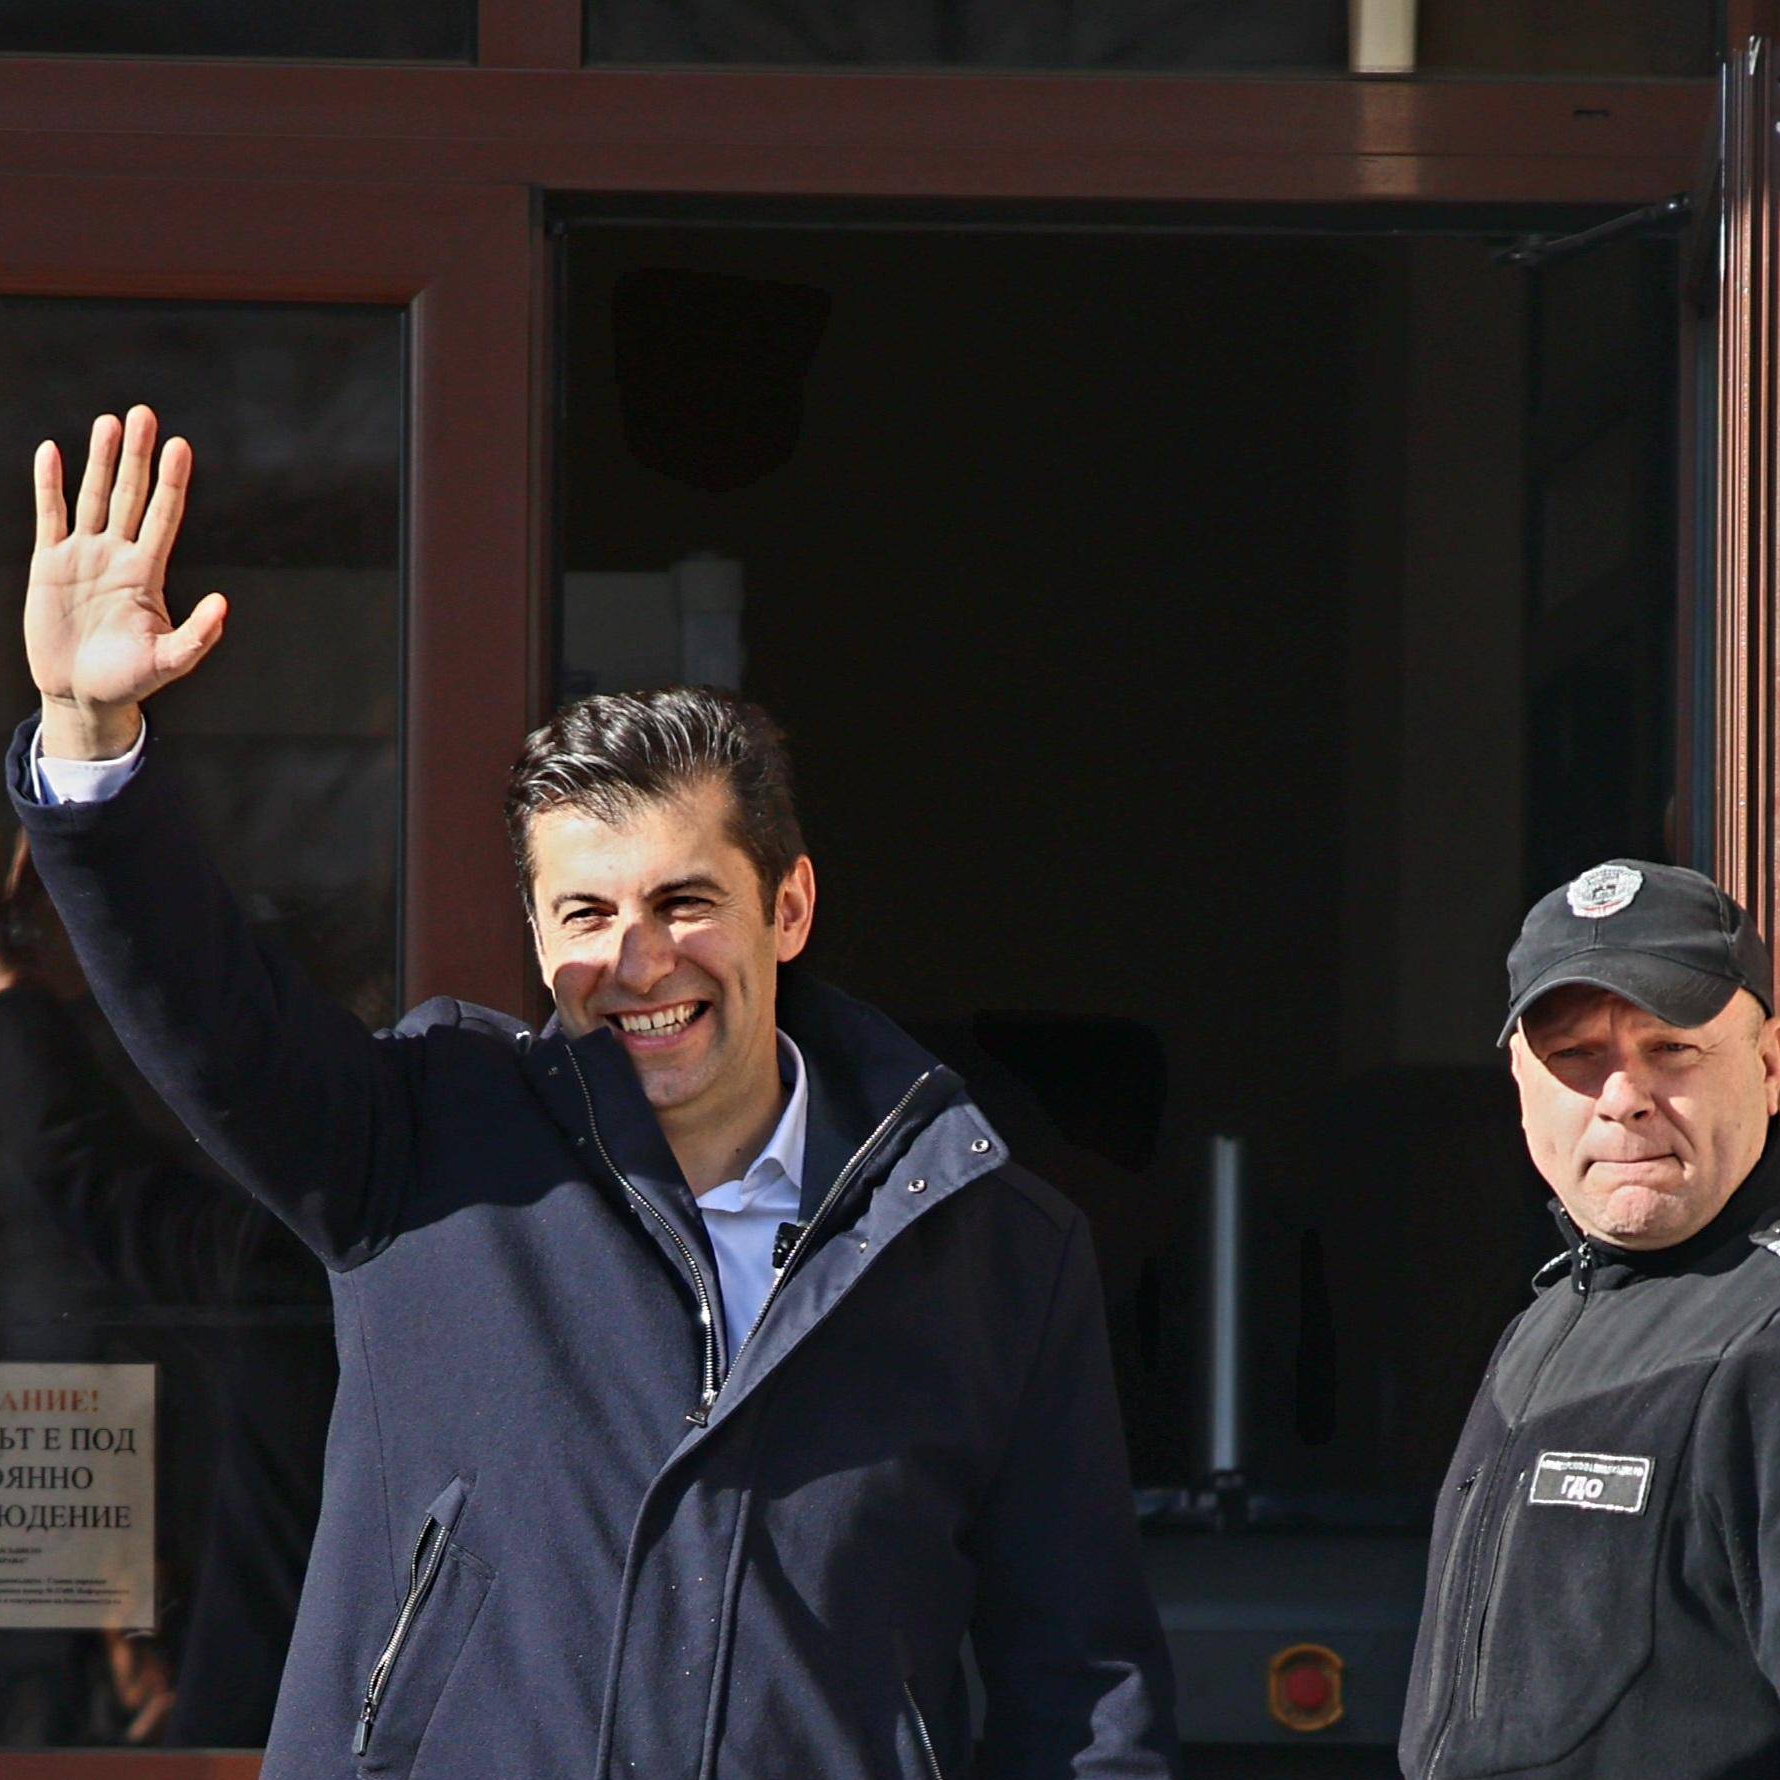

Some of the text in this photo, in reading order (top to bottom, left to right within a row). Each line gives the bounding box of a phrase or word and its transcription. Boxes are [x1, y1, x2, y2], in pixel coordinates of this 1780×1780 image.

[44, 1428, 61, 1451] Е
[70, 1427, 137, 1454] ПОД
[1560, 1474, 1605, 1501] ГДО
